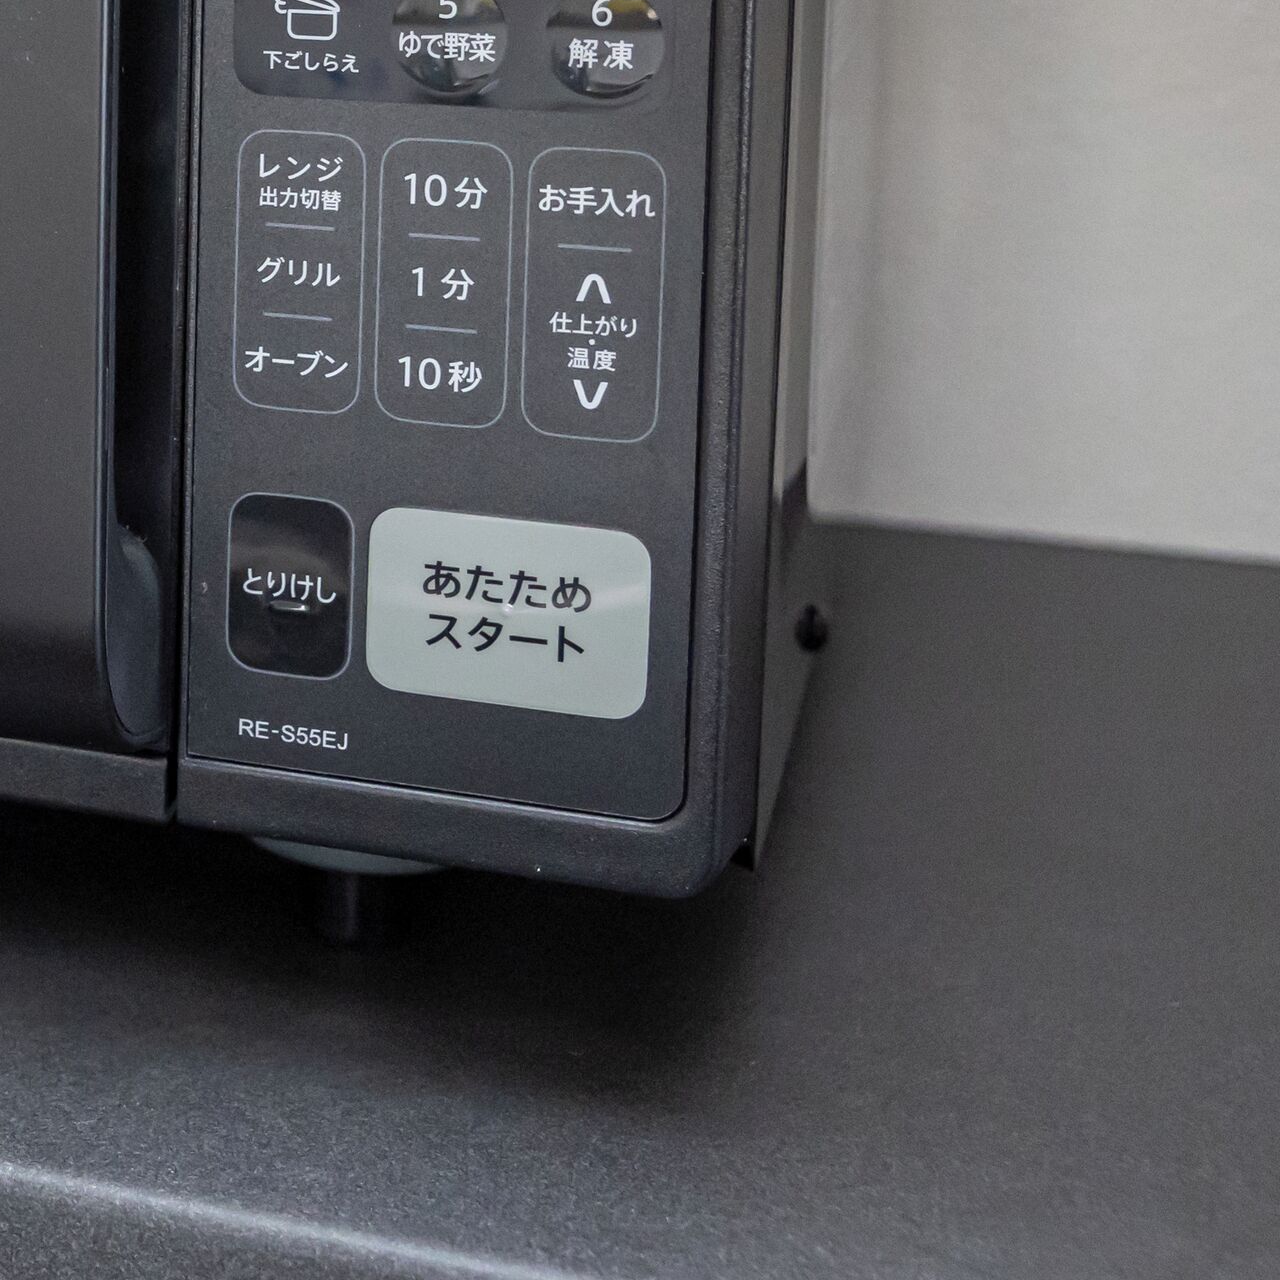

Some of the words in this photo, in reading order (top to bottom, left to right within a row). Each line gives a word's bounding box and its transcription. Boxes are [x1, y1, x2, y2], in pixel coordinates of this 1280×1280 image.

[263, 51, 359, 73] 下ごしらえ
[398, 32, 496, 63] ゆで野菜
[568, 38, 634, 70] 解凍
[259, 153, 344, 182] レンジ
[259, 187, 341, 212] 出力切替
[538, 184, 656, 218] お手入れ
[257, 257, 341, 287] グリル
[549, 312, 638, 338] 仕上がり
[244, 346, 349, 379] オーブン
[567, 347, 616, 372] 温度
[242, 567, 337, 605] とりけし
[422, 560, 591, 614] あたため
[426, 613, 584, 663] スタート
[238, 718, 348, 750] RE-S55EJ
